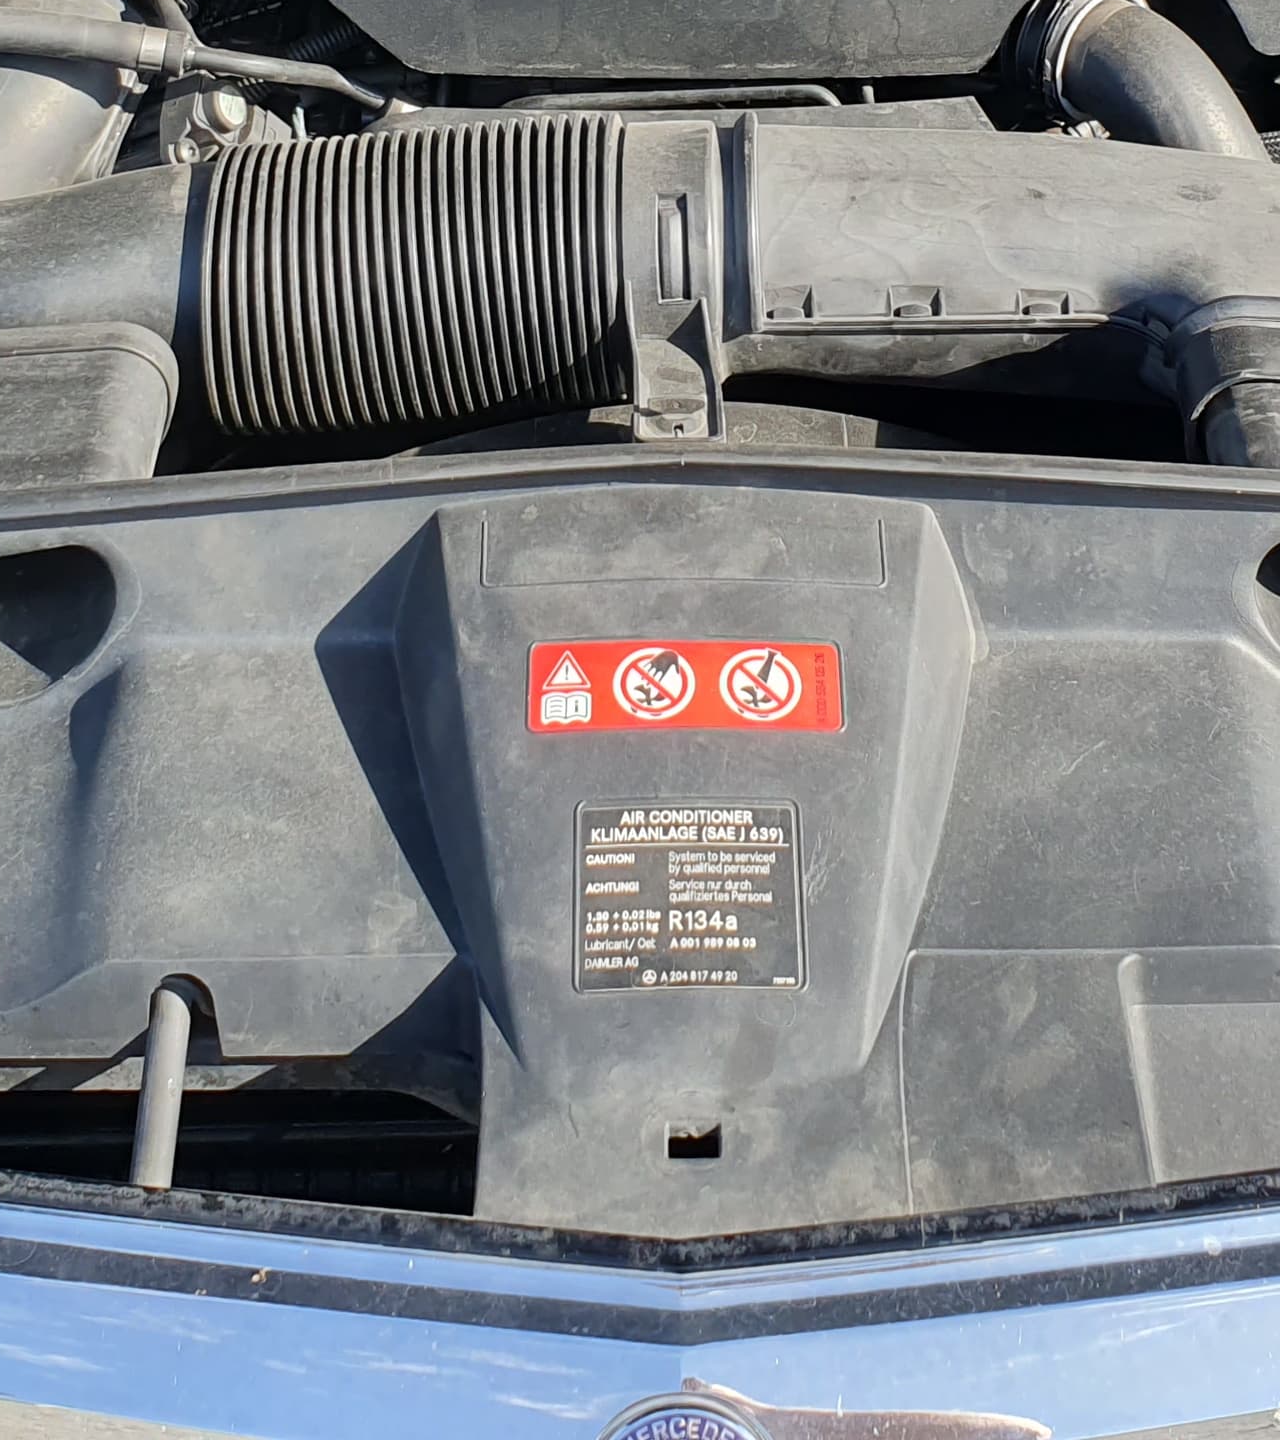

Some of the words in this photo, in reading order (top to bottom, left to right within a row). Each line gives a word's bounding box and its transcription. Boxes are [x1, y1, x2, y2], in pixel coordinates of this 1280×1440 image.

[620, 810, 645, 826] AIR
[649, 809, 753, 825] CONDITIONER
[591, 826, 698, 843] KLIMAANLAGE
[702, 826, 736, 843] (SAE
[739, 827, 746, 842] J
[749, 827, 784, 844] 639)
[668, 851, 706, 865] System
[707, 851, 718, 862] to
[720, 851, 733, 862] be
[734, 851, 776, 863] serviced
[668, 863, 681, 877] by
[668, 879, 705, 891] Service
[668, 909, 738, 931] R134a
[670, 937, 679, 949] A
[584, 957, 624, 970] DAIMLER
[624, 956, 640, 968] AG
[660, 971, 669, 983] A
[724, 971, 738, 981] 20
